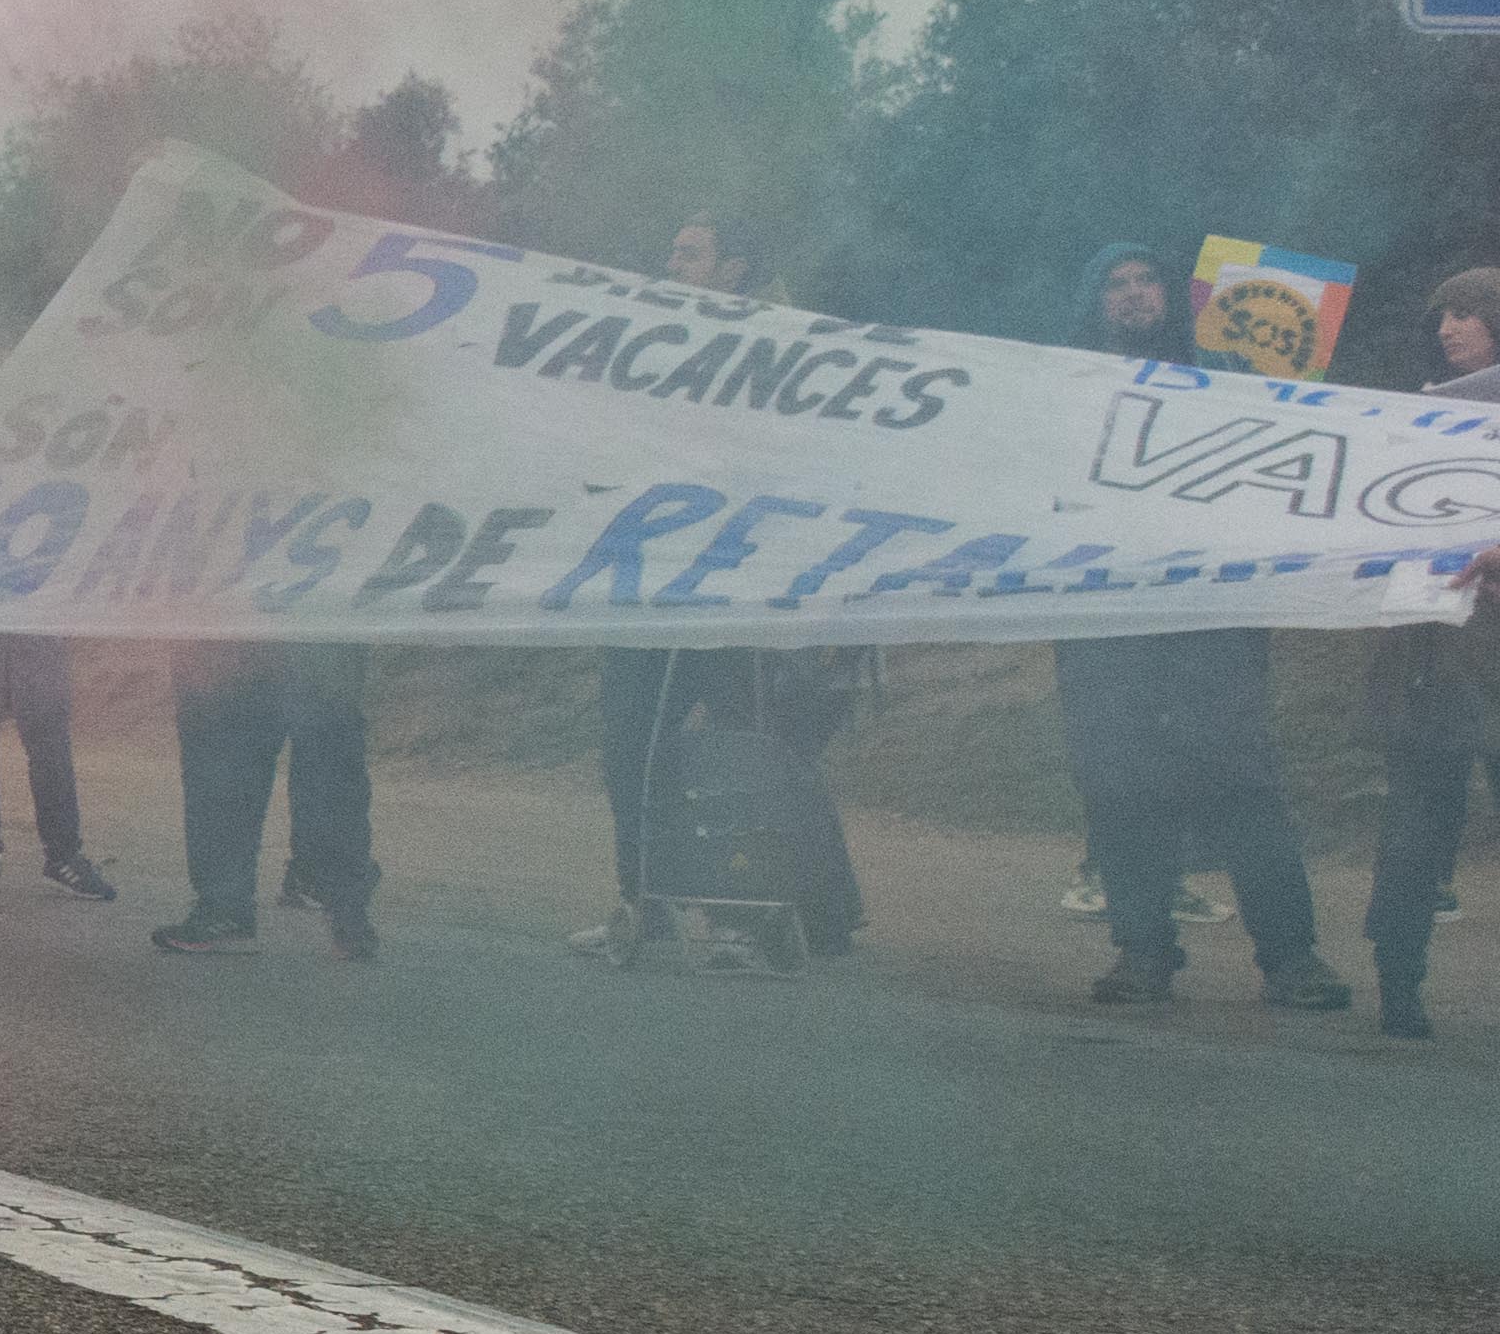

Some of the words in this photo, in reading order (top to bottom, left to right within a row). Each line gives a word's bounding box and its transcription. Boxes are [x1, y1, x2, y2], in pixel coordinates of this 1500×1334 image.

[308, 233, 524, 343] 5
[493, 300, 971, 430] VACANCES
[74, 490, 373, 615] ANYS
[353, 502, 556, 613] DE
